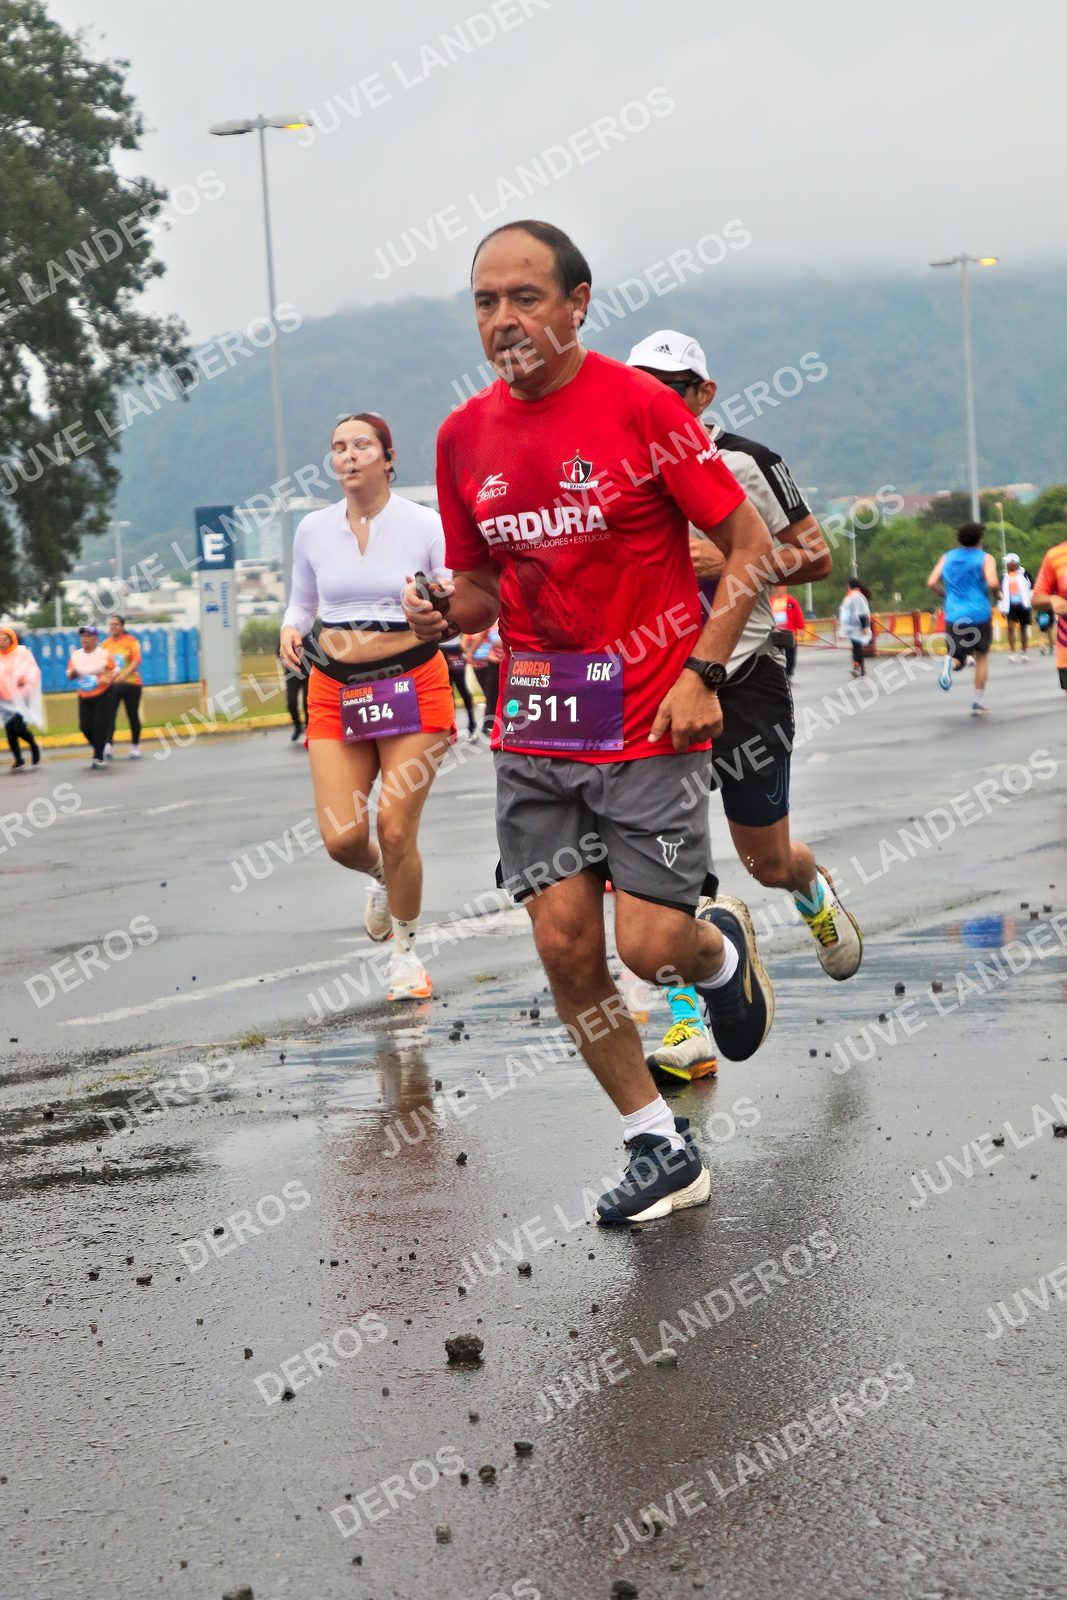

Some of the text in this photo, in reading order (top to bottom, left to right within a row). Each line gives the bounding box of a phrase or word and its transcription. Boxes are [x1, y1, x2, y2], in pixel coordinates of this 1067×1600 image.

[477, 505, 608, 545] ERDURA
[203, 532, 226, 563] E
[512, 660, 551, 676] CARRERA
[586, 662, 613, 681] 15K
[342, 687, 373, 699] CARRERA
[393, 680, 410, 694] 15K
[358, 703, 394, 723] 134
[527, 694, 578, 722] 511
